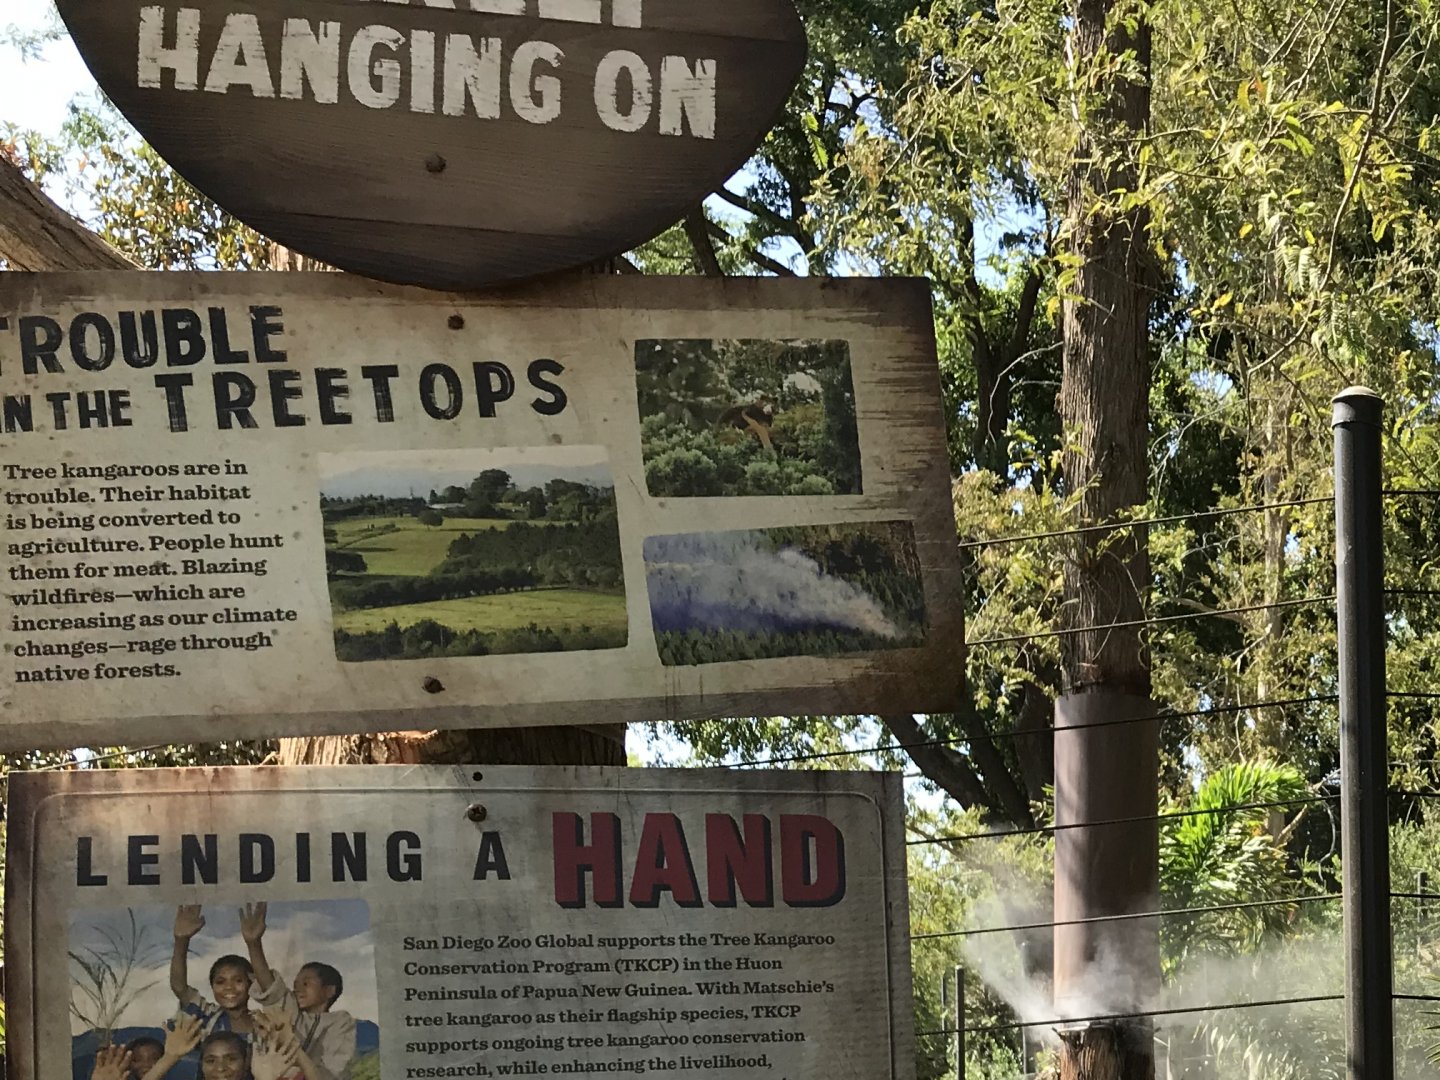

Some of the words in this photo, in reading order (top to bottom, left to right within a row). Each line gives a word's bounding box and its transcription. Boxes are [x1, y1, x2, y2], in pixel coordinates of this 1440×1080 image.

[137, 6, 565, 125] HANGING
[594, 49, 717, 141] ON
[0, 394, 33, 433] N
[46, 390, 133, 430] THE
[154, 359, 568, 433] TREETOPS
[3, 464, 57, 480] Tree
[62, 462, 179, 480] kangaroos
[184, 464, 220, 476] are
[225, 459, 248, 475] in
[5, 488, 96, 504] trouble.
[100, 486, 165, 502] Their
[168, 485, 251, 501] habitat
[7, 514, 27, 530] is
[31, 513, 95, 531] being
[99, 511, 213, 527] converted
[219, 511, 241, 525] to
[8, 538, 145, 558] agriculture.
[149, 534, 226, 552] People
[230, 533, 283, 549] hunt
[9, 564, 70, 580] them
[74, 562, 109, 578] for
[113, 565, 178, 577] meat.
[182, 559, 267, 575] Blazing
[209, 586, 245, 598] are
[13, 612, 136, 632] increasing
[139, 614, 164, 626] as
[168, 614, 208, 626] our
[212, 608, 297, 624] climate
[181, 632, 273, 650] through
[15, 667, 90, 683] native
[94, 662, 182, 679] forests.
[75, 830, 423, 887] LENDING
[473, 831, 511, 881] A
[551, 810, 845, 910] HAND
[403, 936, 439, 950] San
[442, 936, 494, 951] Diego
[498, 935, 532, 949] Zoo
[535, 934, 594, 948] Global
[597, 935, 676, 950] supports
[679, 933, 707, 947] the
[710, 933, 750, 945] Tree
[754, 932, 835, 948] Kangaroo
[404, 960, 529, 976] Conservation
[533, 960, 611, 975] Program
[614, 958, 679, 974] (TKCP)
[683, 957, 700, 971] in
[704, 957, 732, 970] the
[735, 957, 782, 970] Huon
[405, 986, 498, 1001] Peninsula
[501, 985, 520, 999] of
[523, 985, 578, 1000] Papua
[582, 985, 622, 997] New
[625, 983, 692, 996] Guinea.
[696, 982, 740, 995] With
[405, 1015, 443, 1026] tree
[447, 1012, 533, 1027] kangaroo
[536, 1012, 555, 1024] as
[559, 1009, 604, 1023] their
[607, 1008, 677, 1024] flagship
[680, 1006, 749, 1022] species,
[751, 1005, 801, 1018] TKCP
[406, 1038, 489, 1054] supports
[492, 1035, 565, 1051] ongoing
[567, 1036, 604, 1048] tree
[607, 1033, 689, 1049] kangaroo
[692, 1029, 806, 1045] conservation
[406, 1063, 493, 1078] research,
[496, 1060, 548, 1075] while
[551, 1056, 645, 1074] enhancing
[648, 1057, 677, 1071] the
[680, 1054, 772, 1069] livelihood,
